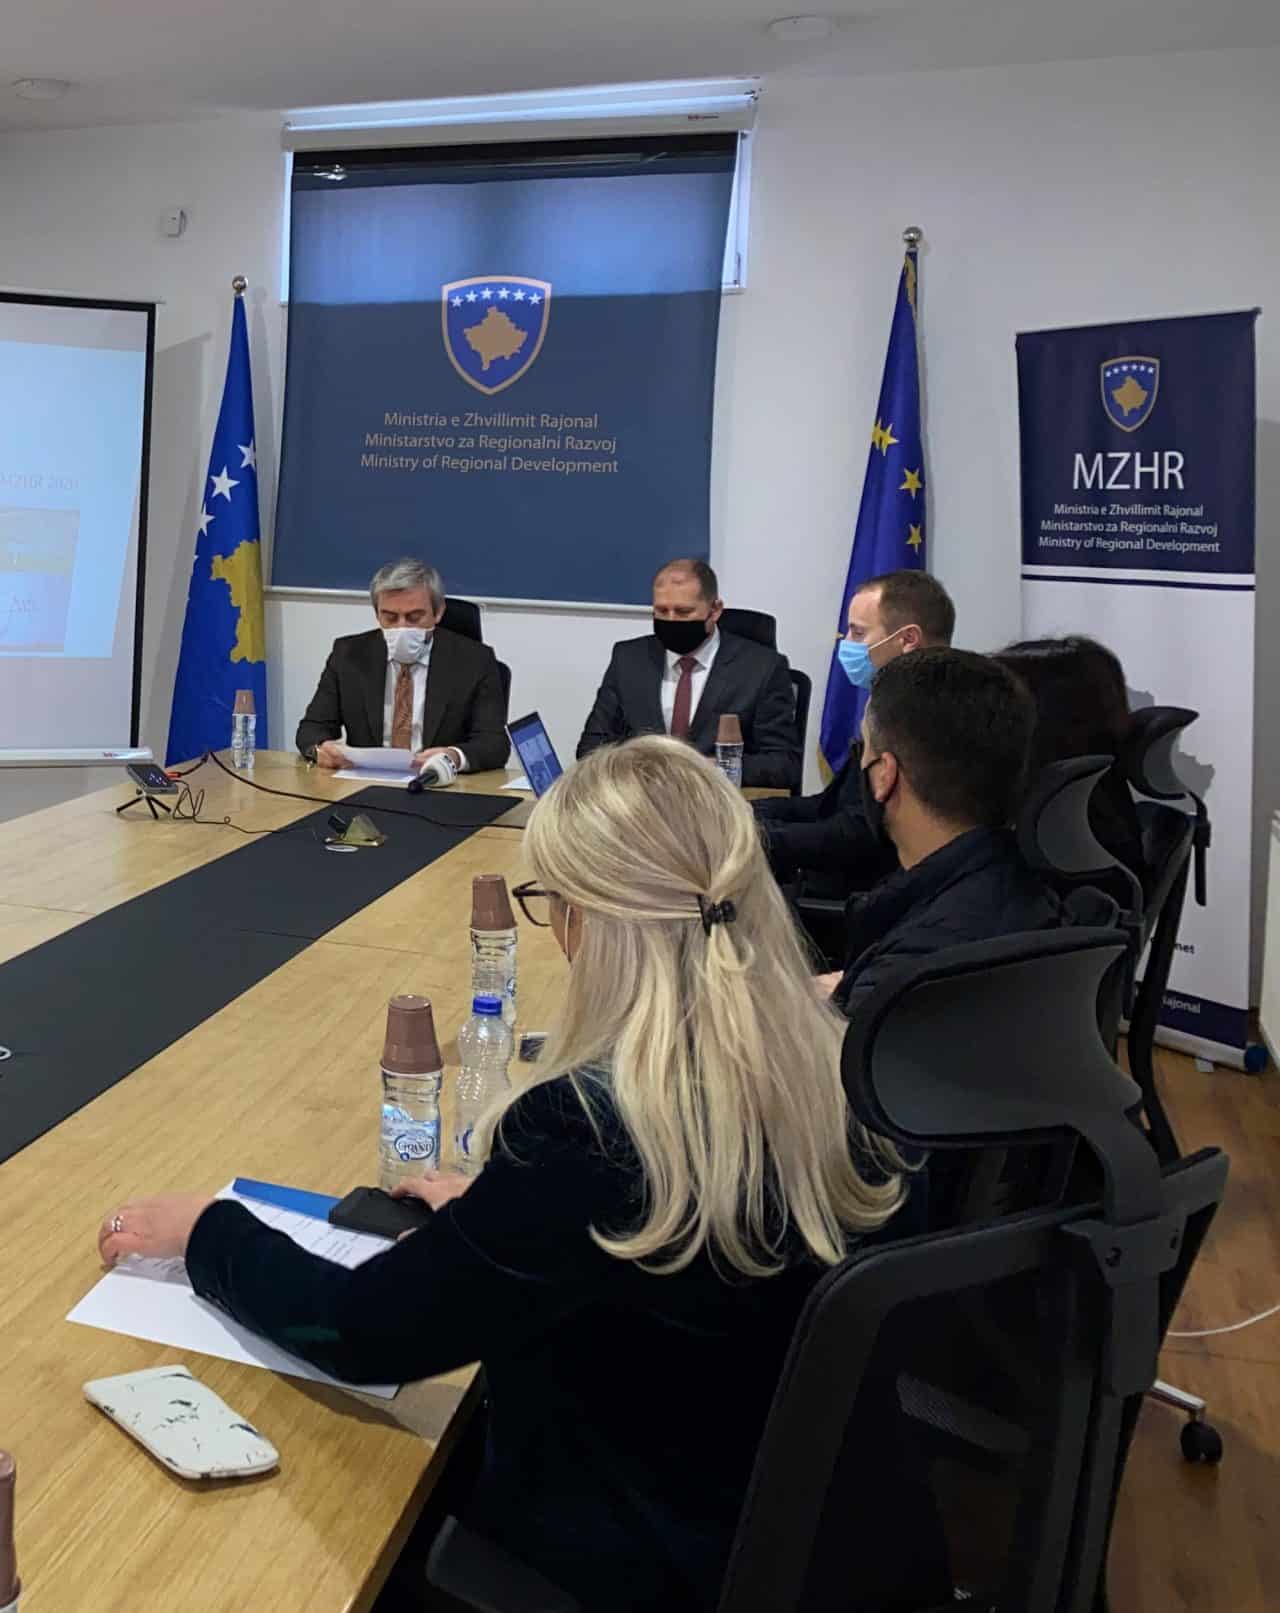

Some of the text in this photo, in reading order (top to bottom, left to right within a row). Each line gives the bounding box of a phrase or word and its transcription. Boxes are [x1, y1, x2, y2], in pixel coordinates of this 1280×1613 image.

[384, 412, 598, 430] Ministria e Zhvillimit Rajonal
[365, 433, 617, 454] Ministarstvo za Regionalni Razvoj
[360, 454, 619, 475] Ministry of Regional Development
[1072, 450, 1185, 490] MZHR
[1054, 503, 1204, 518] Ministria e Zhvillimit Rajonal
[1041, 520, 1218, 538] Ministarstvo za Regionalni Razvoj
[1039, 537, 1220, 553] Ministry of Regional Development
